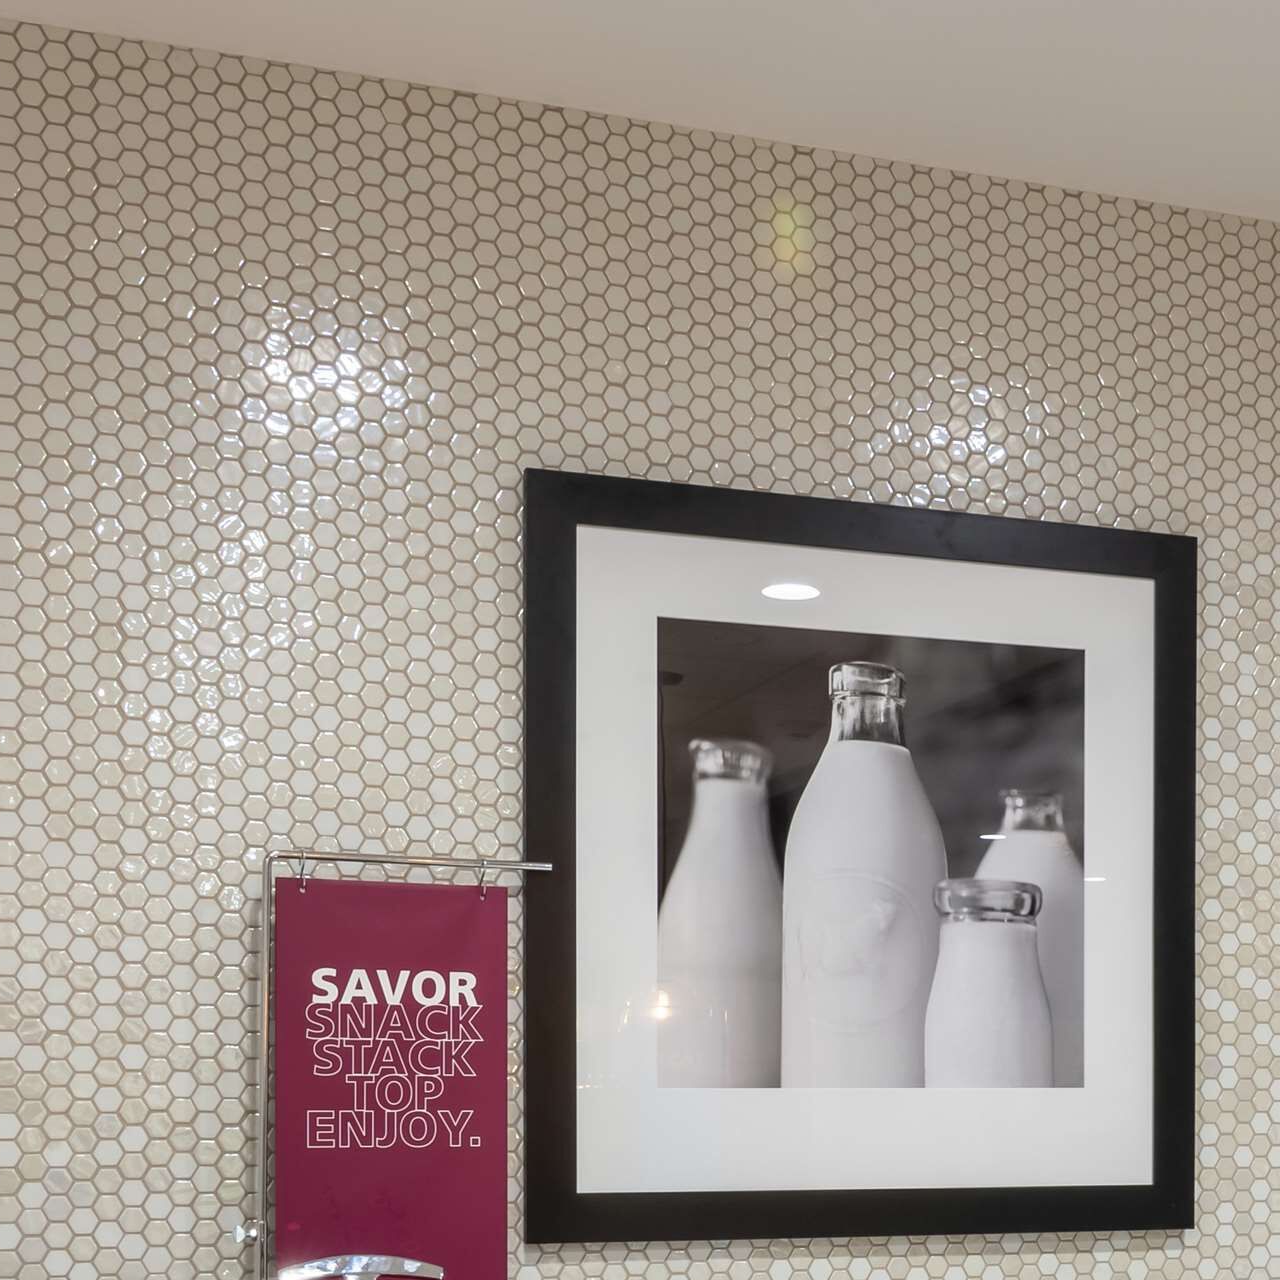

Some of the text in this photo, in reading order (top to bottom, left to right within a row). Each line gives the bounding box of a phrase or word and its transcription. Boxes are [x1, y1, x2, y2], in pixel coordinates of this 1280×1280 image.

[311, 967, 478, 1006] SAVOR
[305, 1002, 484, 1042] SNACK
[313, 1037, 476, 1077] STACK
[345, 1073, 444, 1112] TOP
[306, 1110, 481, 1149] ENJOY.
